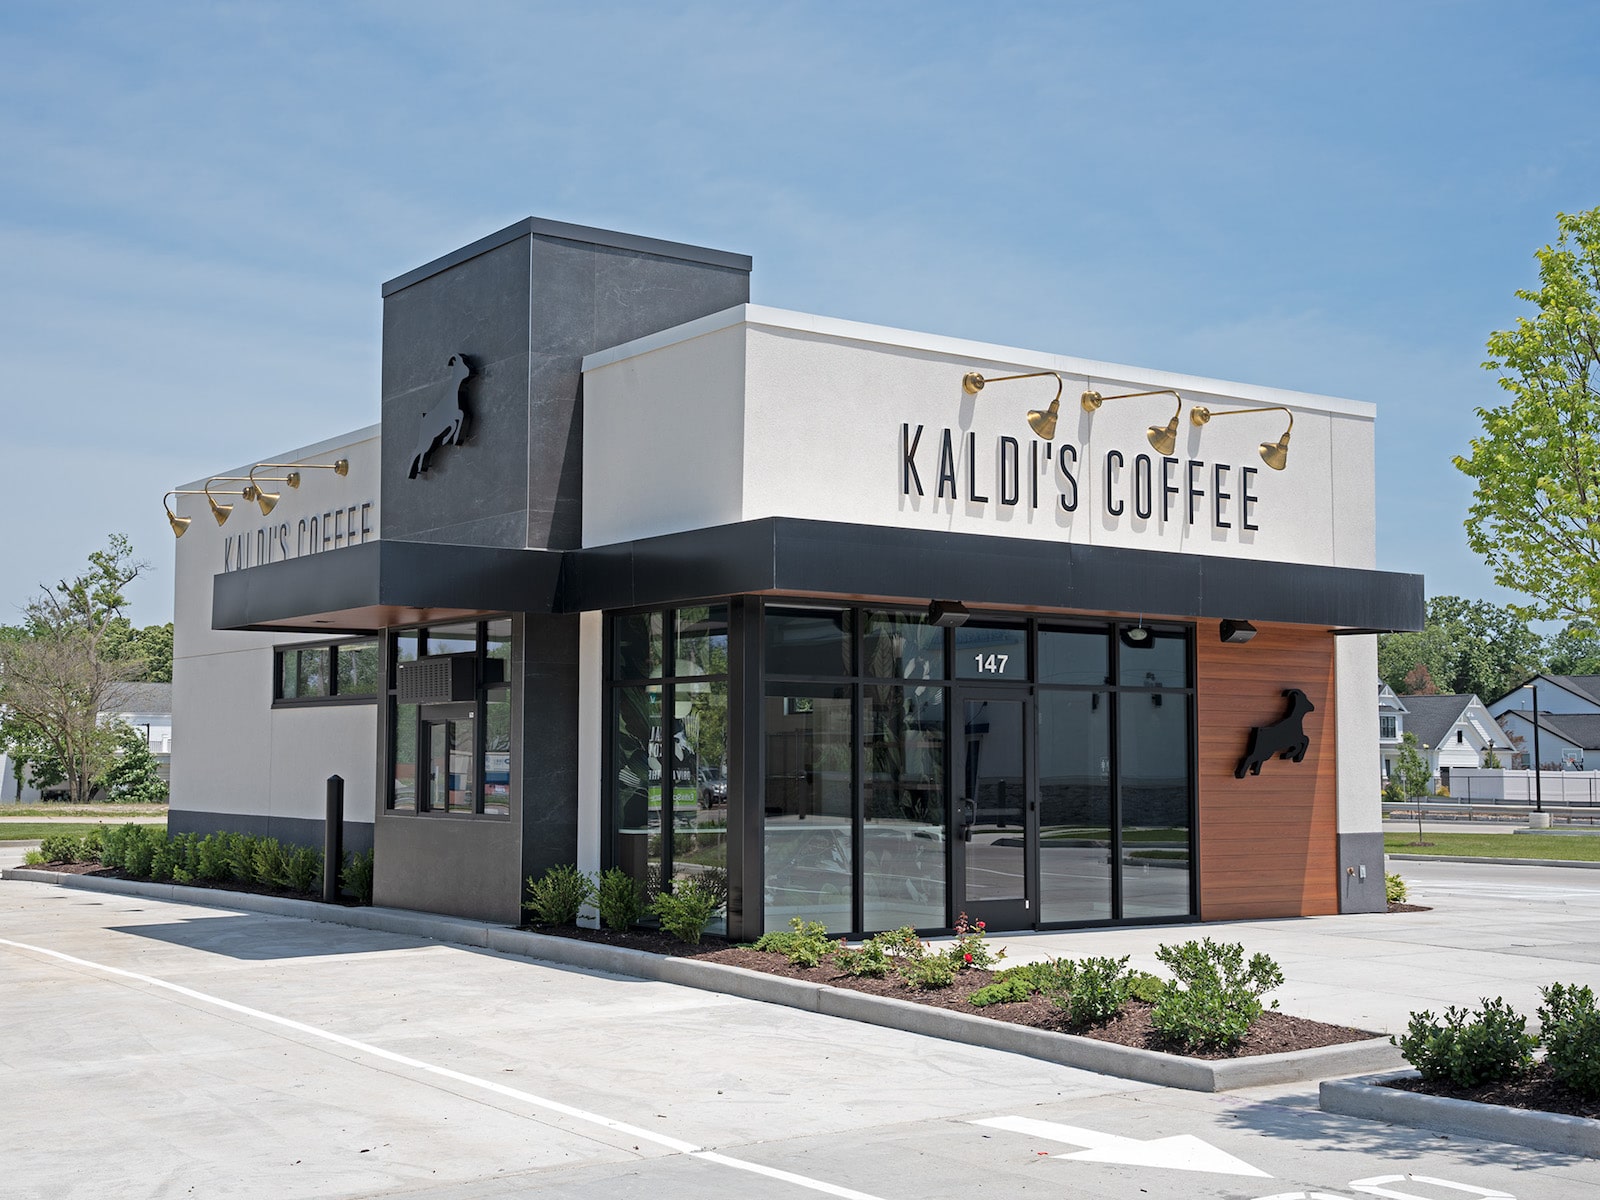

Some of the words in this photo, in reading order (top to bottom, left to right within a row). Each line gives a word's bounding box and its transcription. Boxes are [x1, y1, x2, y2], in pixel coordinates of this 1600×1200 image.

[902, 423, 1078, 512] KALDI'S
[1107, 450, 1259, 530] COFFEE
[975, 654, 1009, 674] 147
